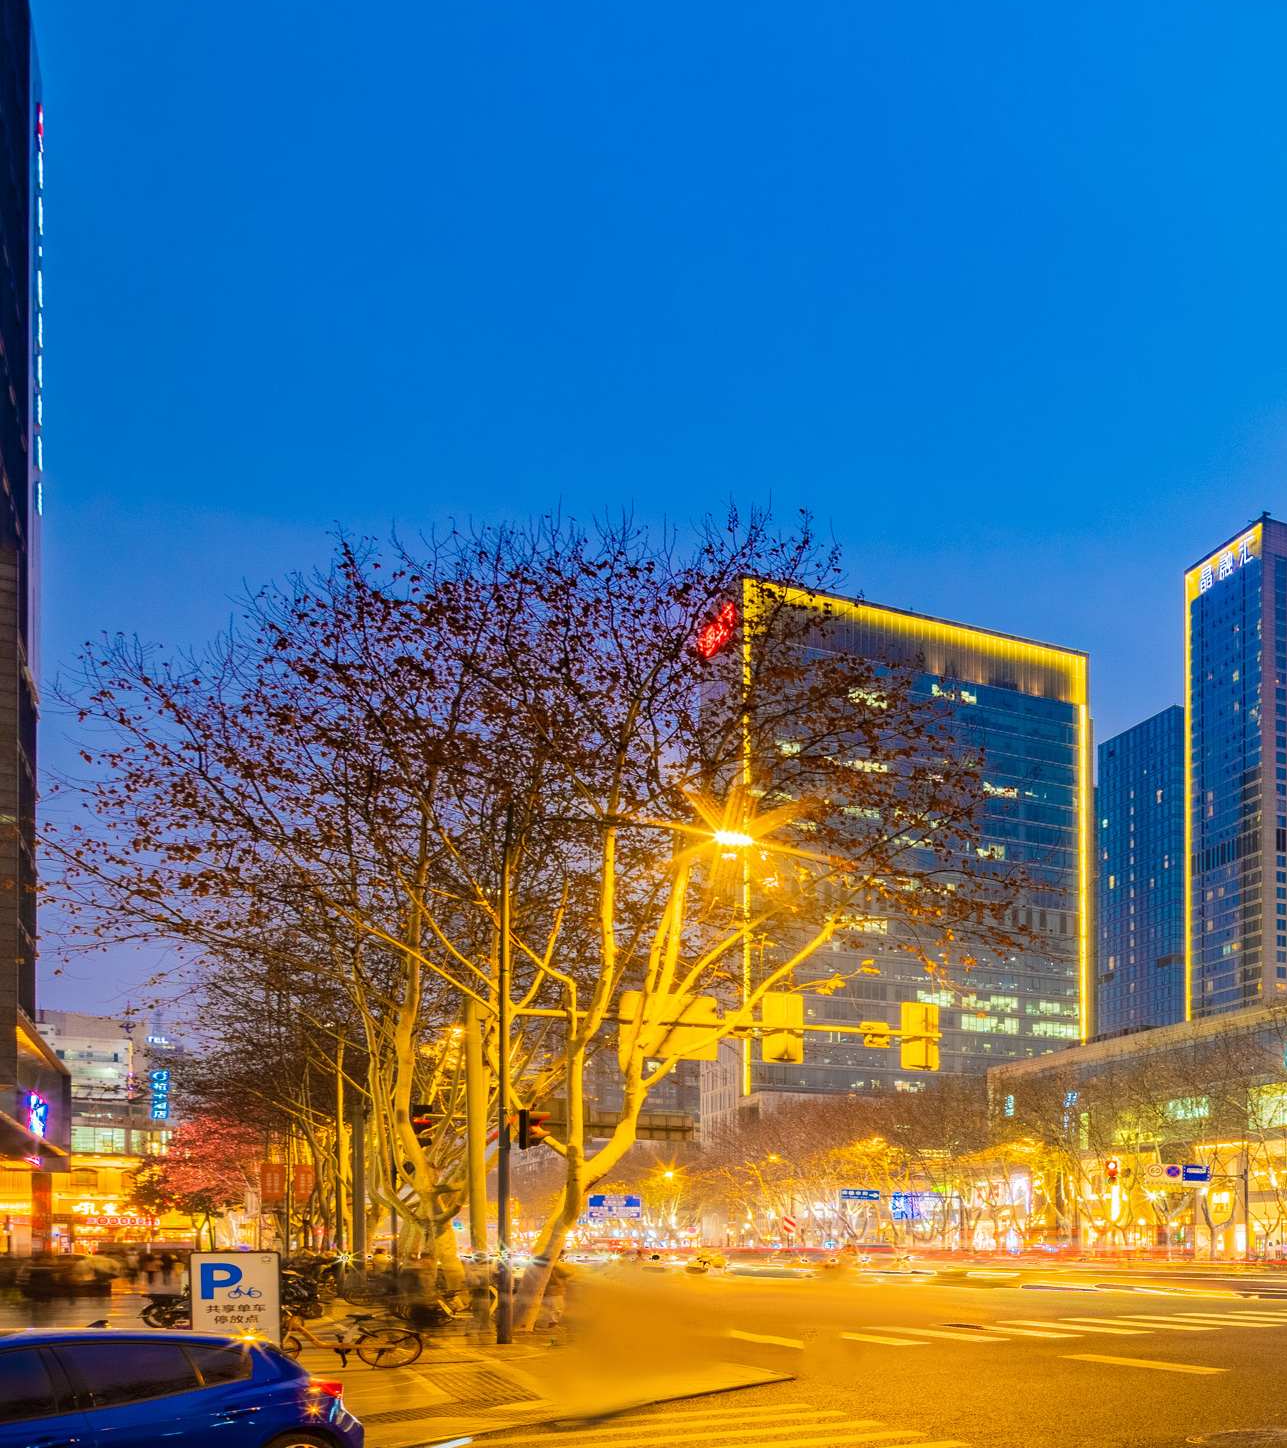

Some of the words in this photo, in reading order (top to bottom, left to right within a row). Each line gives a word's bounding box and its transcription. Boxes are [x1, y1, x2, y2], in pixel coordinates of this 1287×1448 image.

[1199, 535, 1254, 594] 晶融汇
[200, 1263, 242, 1300] P
[206, 1303, 266, 1313] 共享单车
[214, 1315, 259, 1324] 停放点
